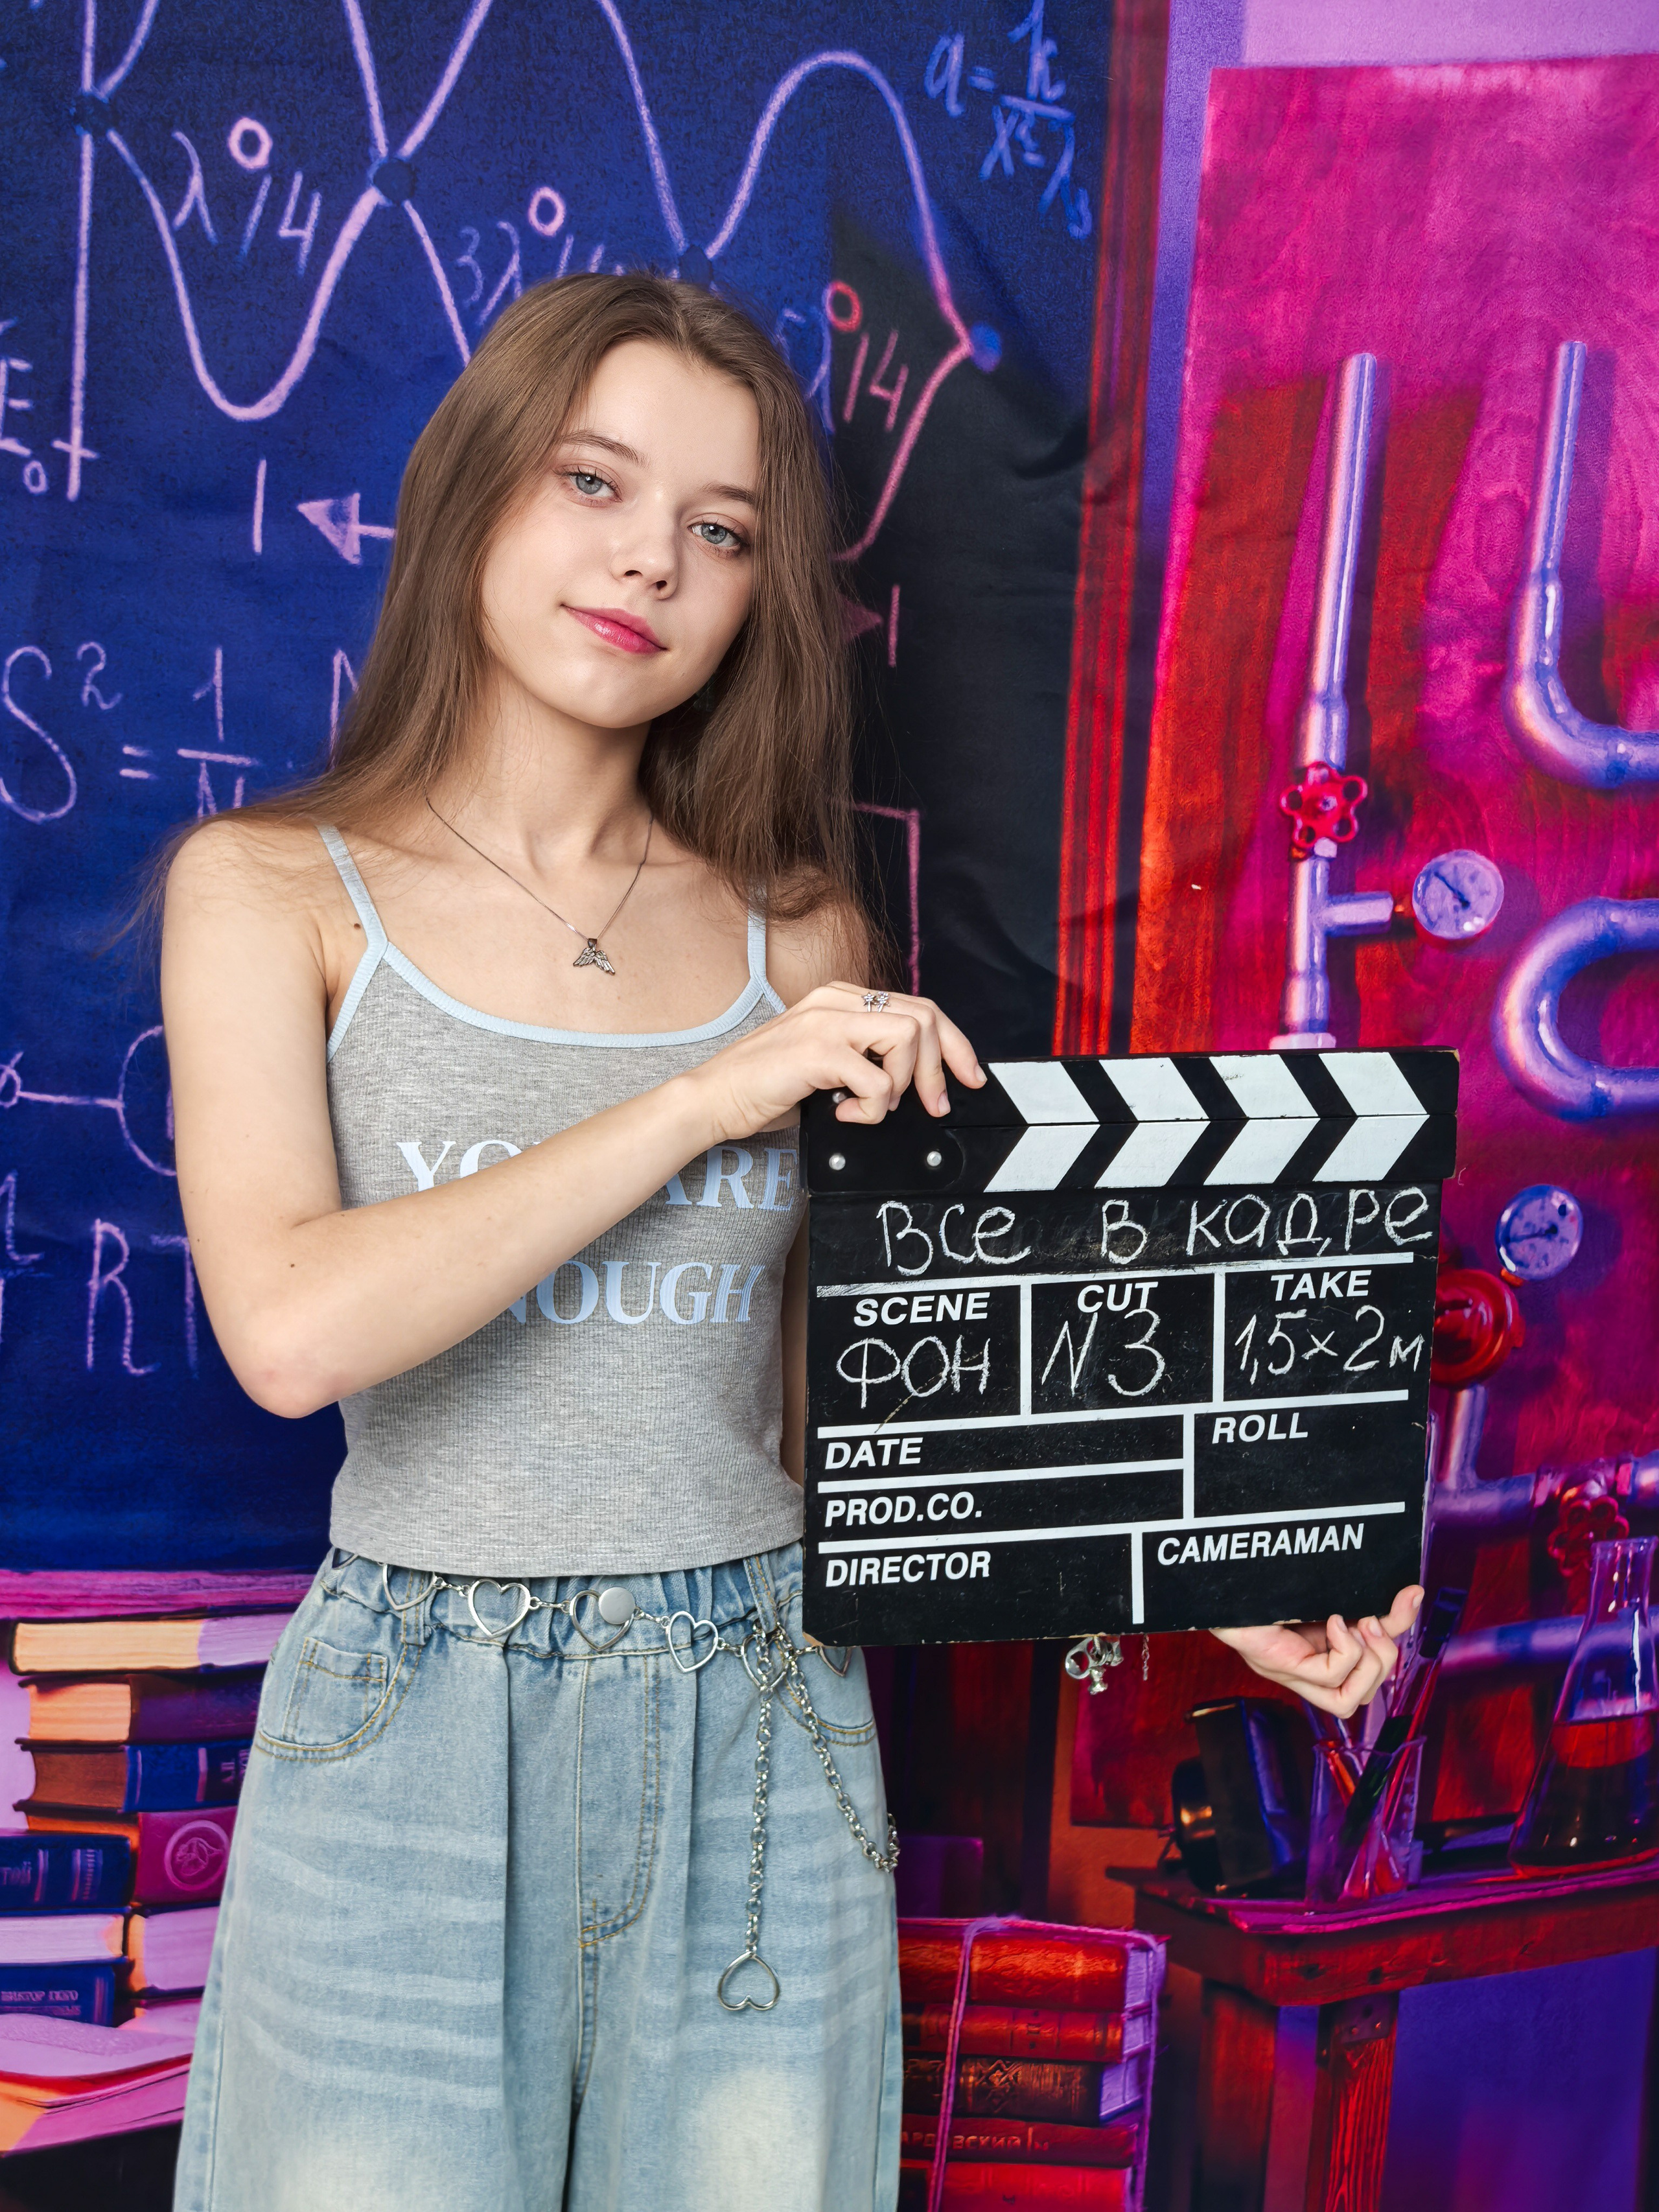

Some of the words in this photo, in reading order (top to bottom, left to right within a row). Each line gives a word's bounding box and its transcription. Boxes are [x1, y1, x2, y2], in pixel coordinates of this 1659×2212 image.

[508, 1259, 766, 1325] OUGH
[1077, 1281, 1159, 1313] CUT
[1270, 1269, 1373, 1301] TAKE
[853, 1292, 991, 1327] SCENE
[1211, 1412, 1309, 1445] ROLL
[824, 1436, 924, 1470] DATE
[824, 1491, 983, 1528] PROD.CO.
[1157, 1522, 1365, 1566] CAMERAMAN
[825, 1550, 992, 1587] DIRECTOR
